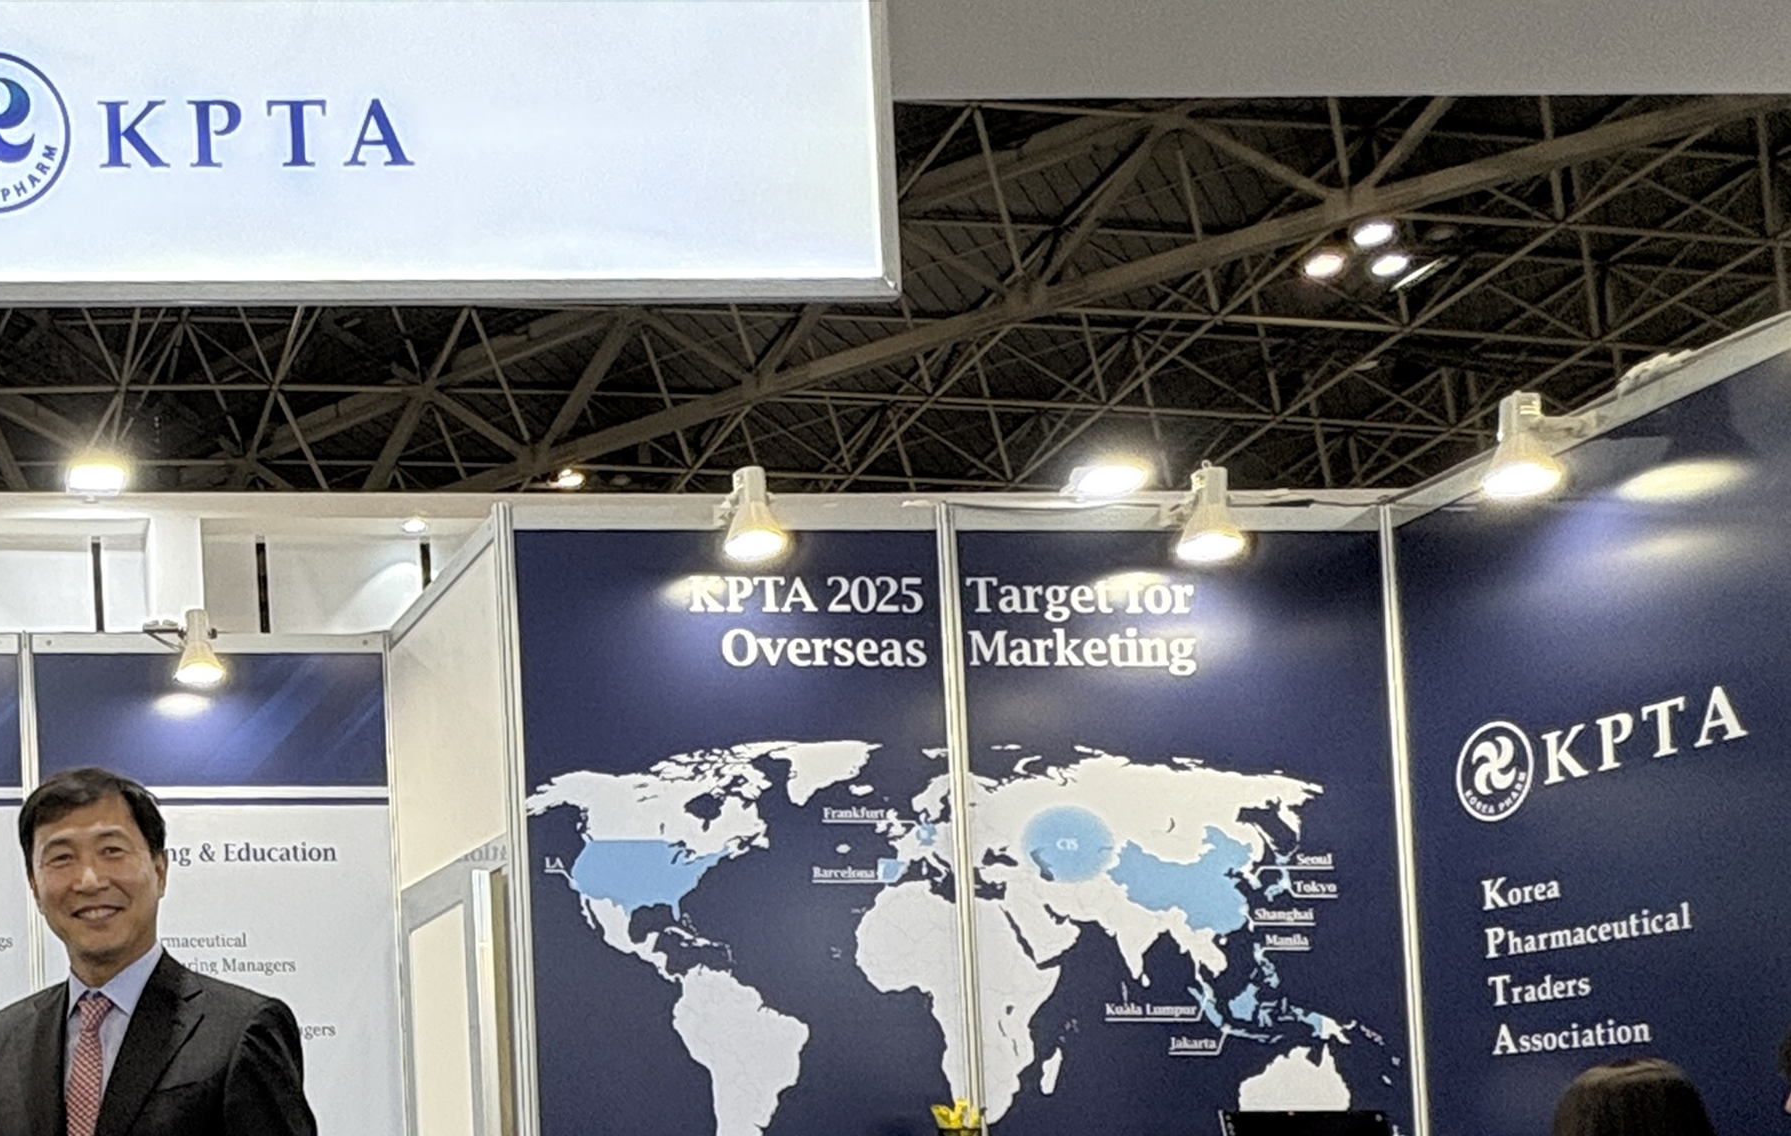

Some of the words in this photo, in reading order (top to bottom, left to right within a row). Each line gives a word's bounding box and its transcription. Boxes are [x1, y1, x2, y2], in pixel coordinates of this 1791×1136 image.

[96, 97, 416, 169] KPTA
[0, 144, 59, 202] PHARM
[688, 576, 817, 614] KPTA
[826, 576, 924, 614] 2025
[965, 576, 1113, 623] Target
[1123, 580, 1196, 615] for
[721, 627, 928, 669] Overseas
[967, 627, 1197, 677] Marketing
[1541, 684, 1749, 786] KPTA
[823, 807, 886, 819] Frankfurt
[198, 843, 216, 862] &
[223, 842, 338, 863] Education
[545, 857, 564, 868] LA
[1296, 852, 1333, 866] Seoul
[812, 866, 875, 879] Barcelona
[1293, 881, 1337, 895] Tokyo
[1481, 876, 1561, 912] Korea
[1253, 907, 1315, 923] Shanghai
[1264, 933, 1309, 947] Manila
[1485, 902, 1693, 960] Pharmaceutical
[222, 957, 297, 976] Managers
[1488, 973, 1592, 1007] Traders
[1105, 1002, 1143, 1016] Kuala
[1145, 1003, 1198, 1018] Lumpur
[1169, 1036, 1217, 1051] Jakarta
[1492, 1018, 1653, 1056] Association
